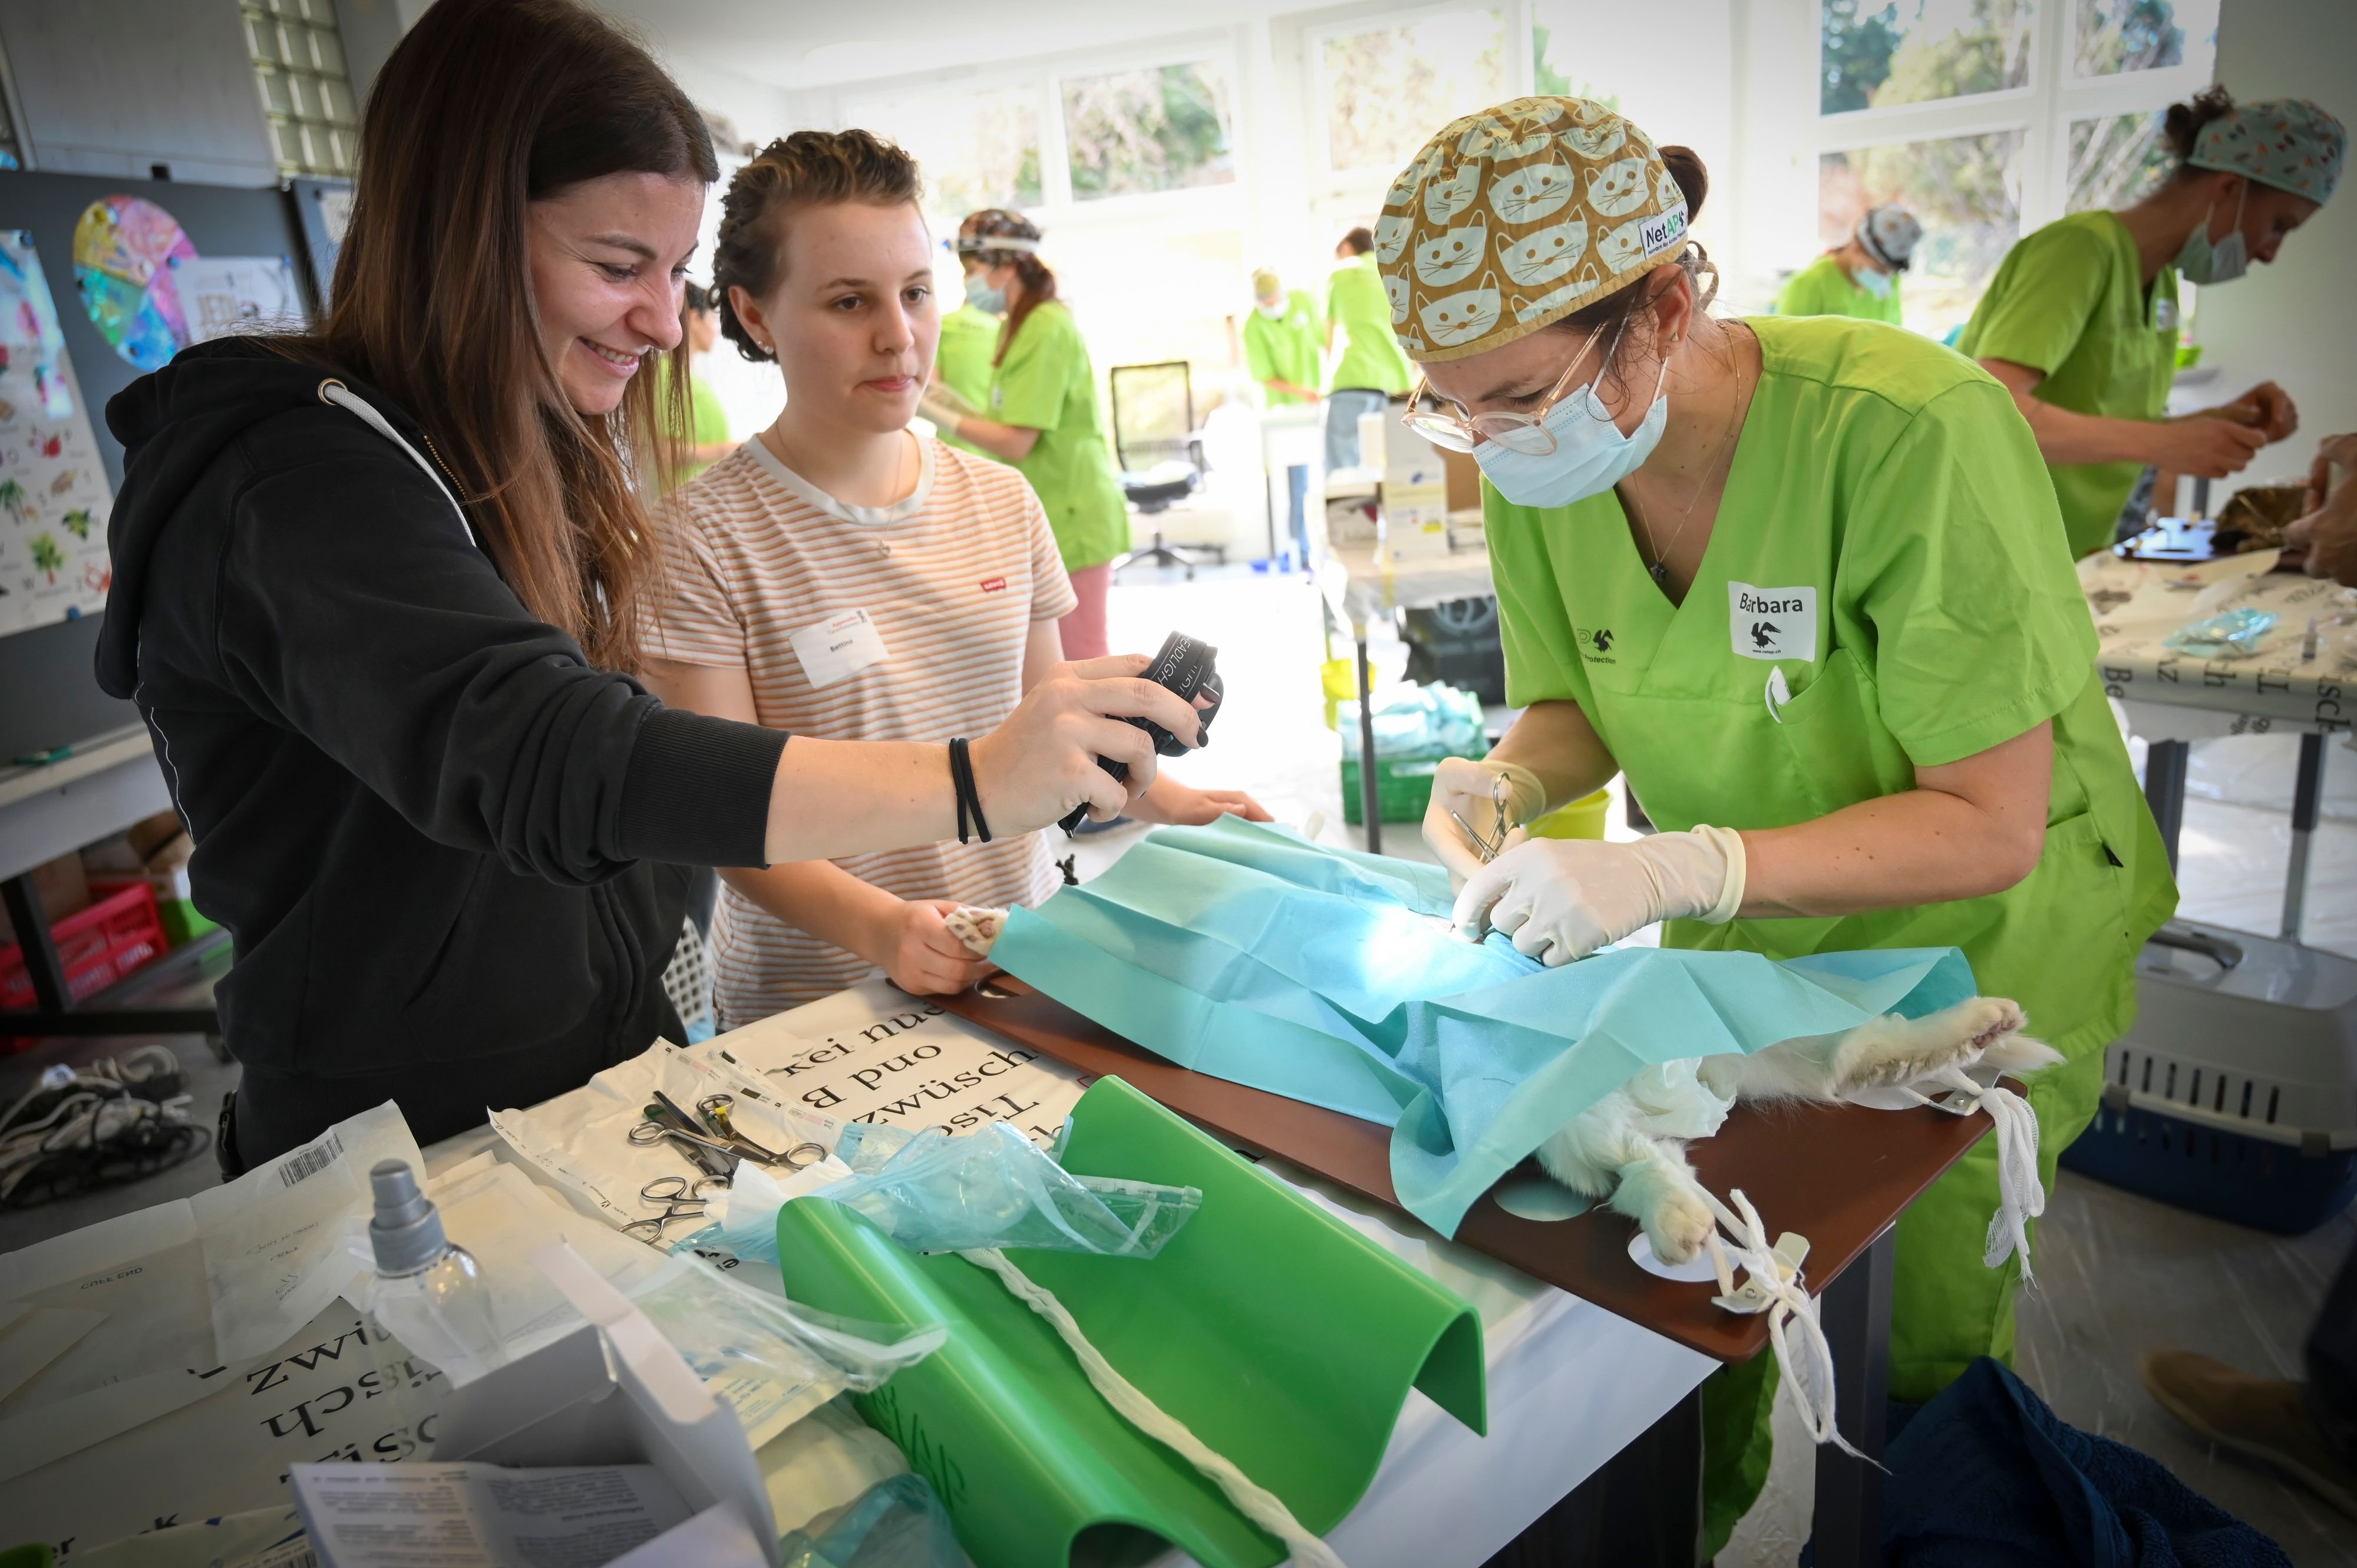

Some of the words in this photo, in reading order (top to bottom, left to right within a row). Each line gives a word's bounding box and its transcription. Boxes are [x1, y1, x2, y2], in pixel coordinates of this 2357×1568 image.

[1739, 592, 1803, 614] Barbara
[830, 639, 854, 652] Bettina
[1157, 636, 1192, 686] HEADLIGH
[852, 1049, 1042, 1125] zwüsch
